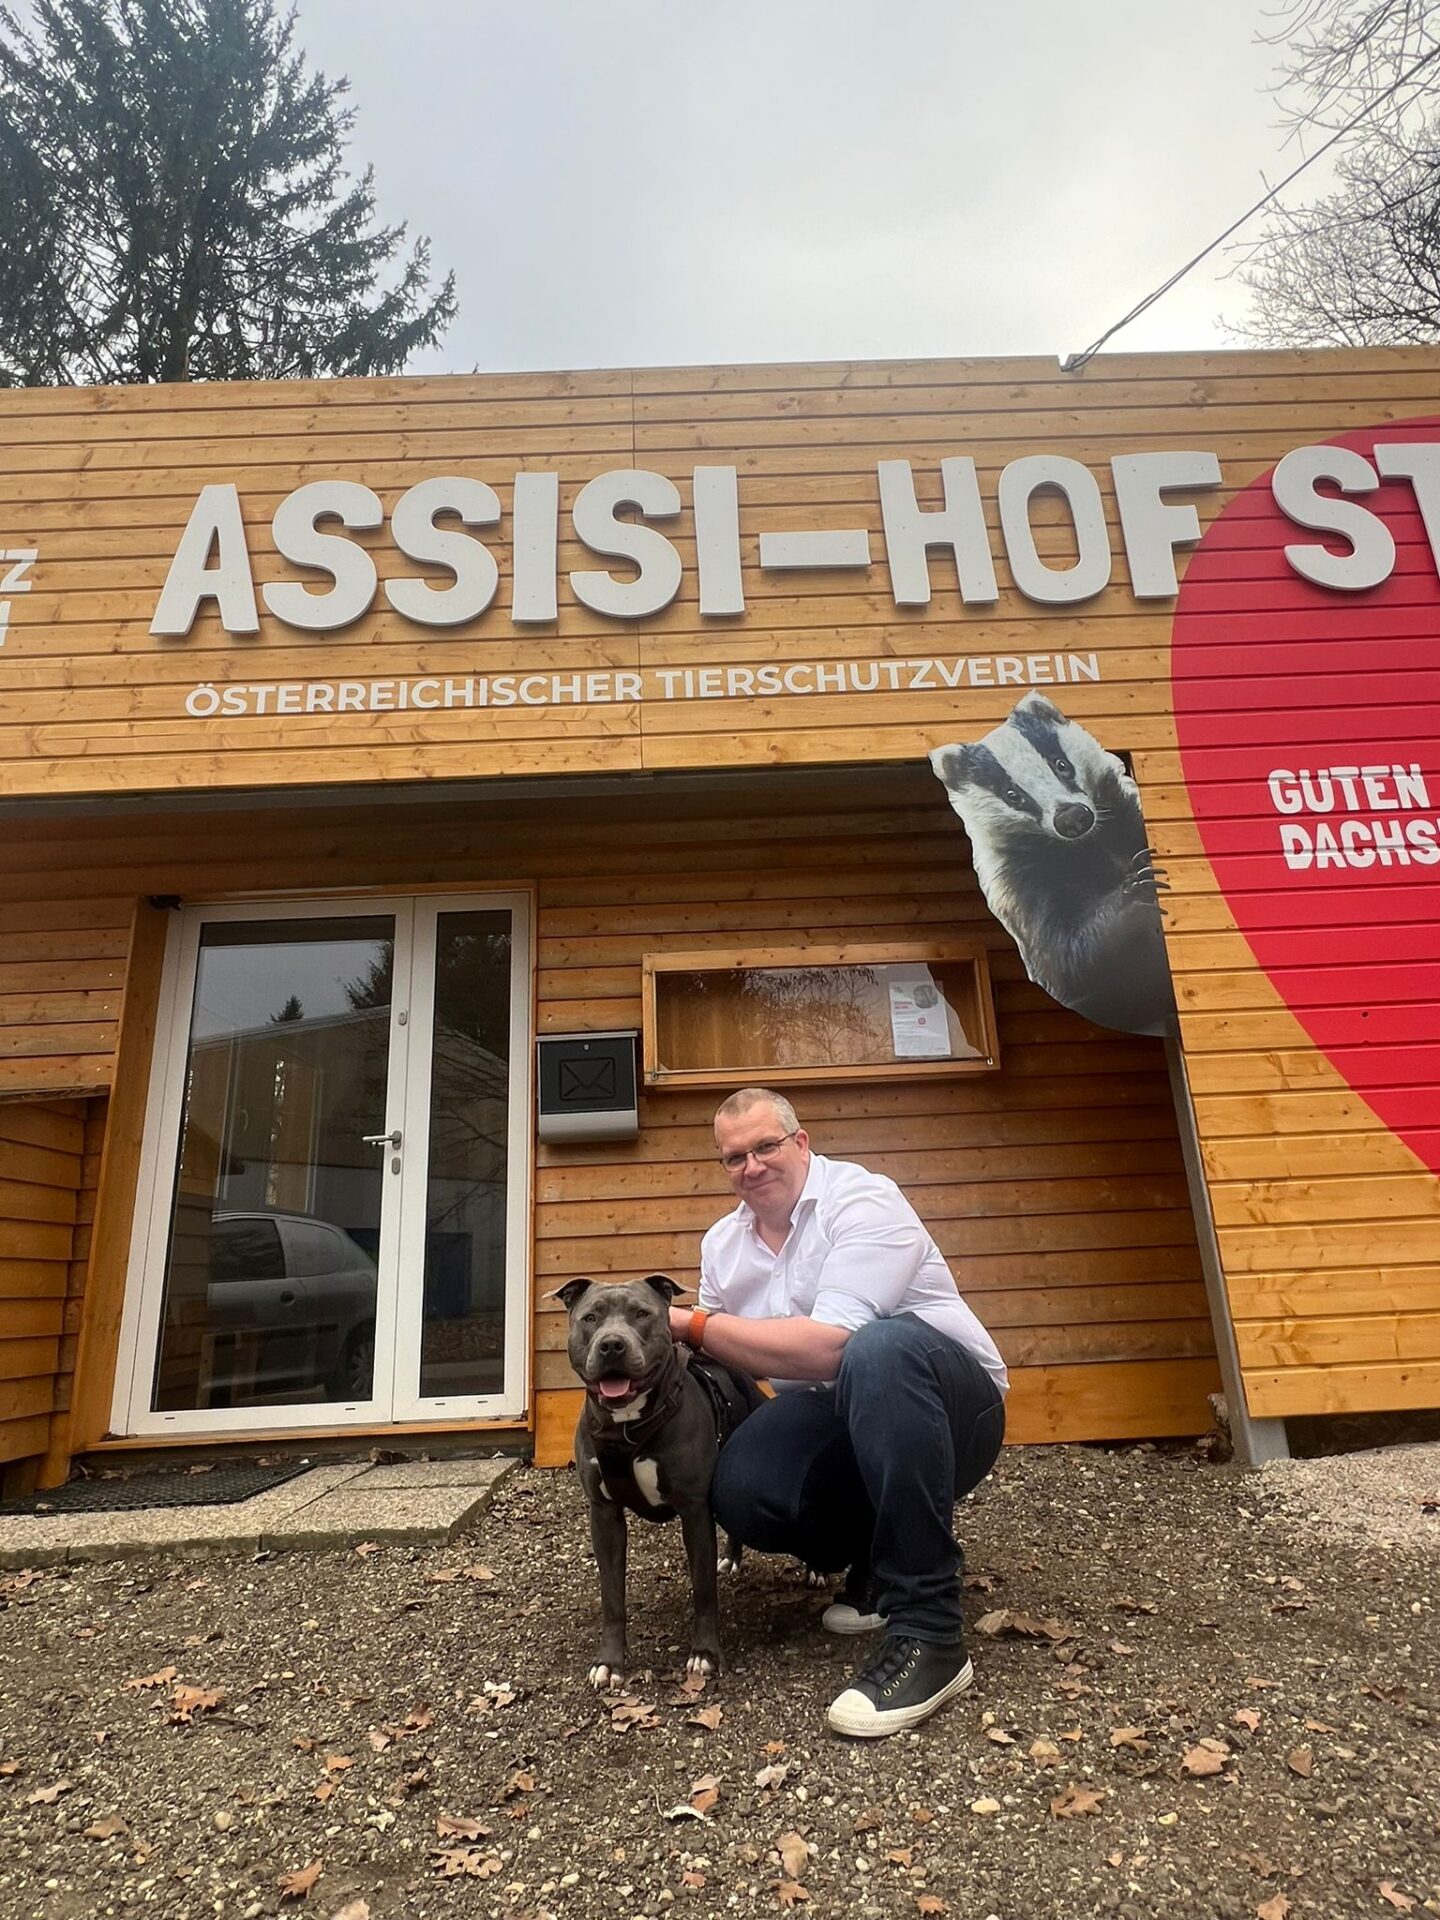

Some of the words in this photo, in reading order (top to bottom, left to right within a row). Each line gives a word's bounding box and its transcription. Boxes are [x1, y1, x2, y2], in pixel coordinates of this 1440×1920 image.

[185, 672, 643, 717] ÖSTERREICHISCHER
[655, 653, 1101, 699] TIERSCHUTZVEREIN
[1268, 763, 1431, 814] GUTEN
[1279, 817, 1440, 870] DACHS
